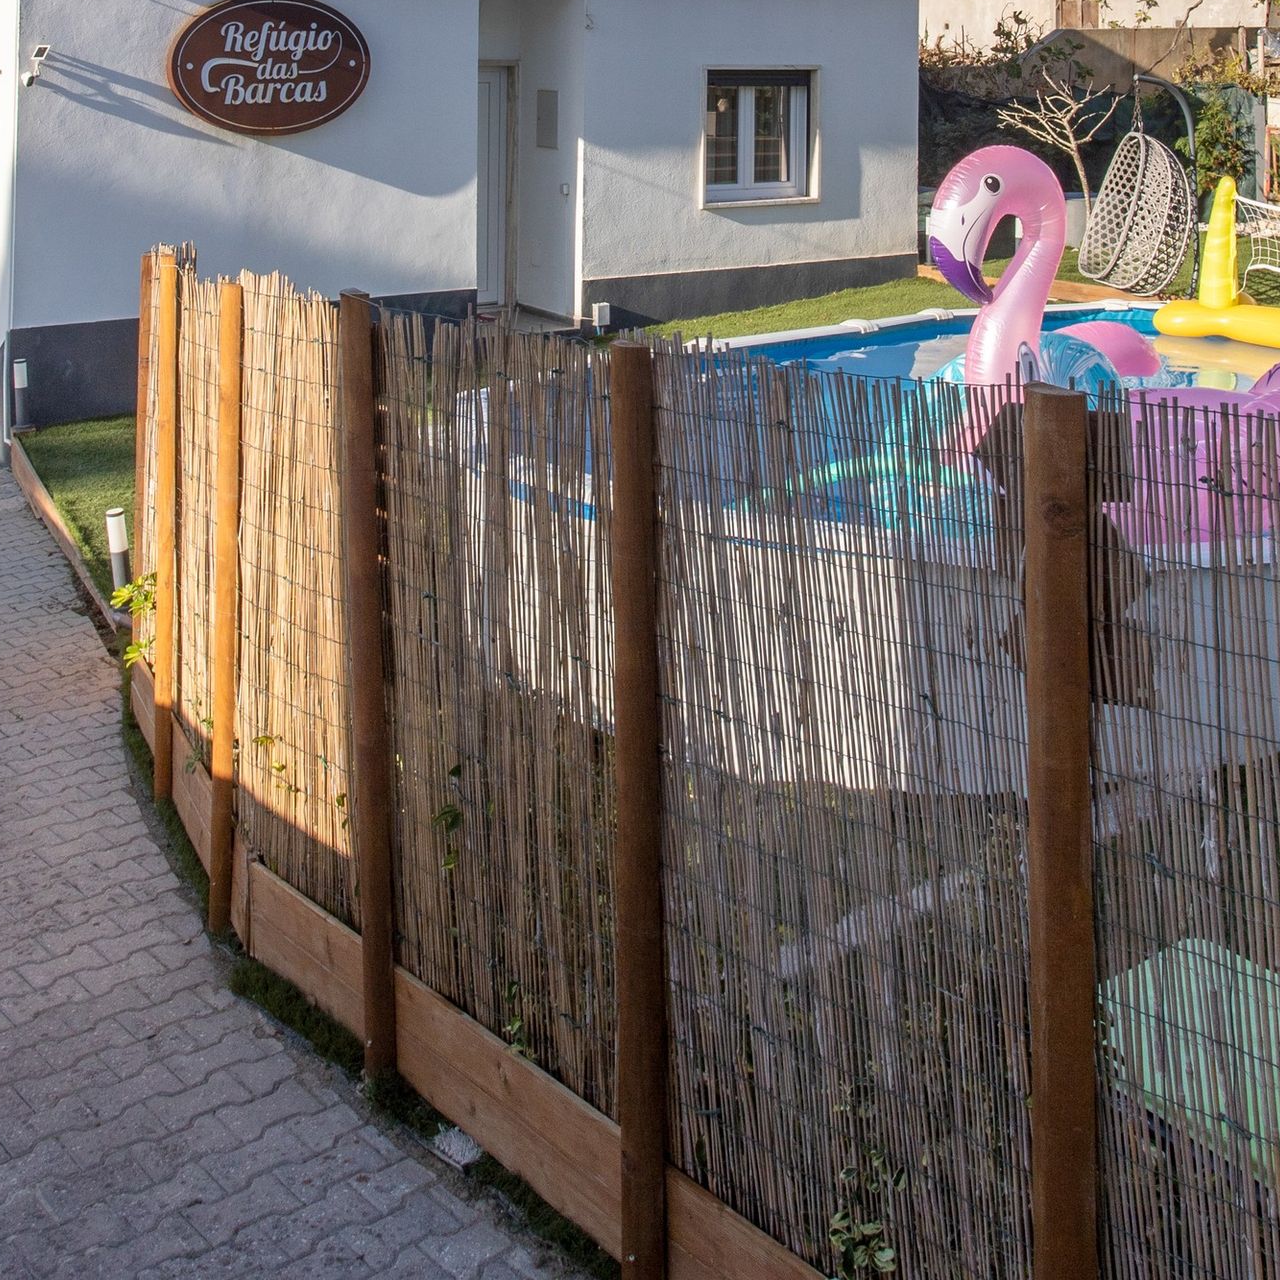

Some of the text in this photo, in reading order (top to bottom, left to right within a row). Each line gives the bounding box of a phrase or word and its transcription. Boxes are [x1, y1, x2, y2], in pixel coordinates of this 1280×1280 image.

[221, 21, 333, 61] Refúgio
[256, 58, 299, 80] das
[221, 74, 328, 105] Barcas
